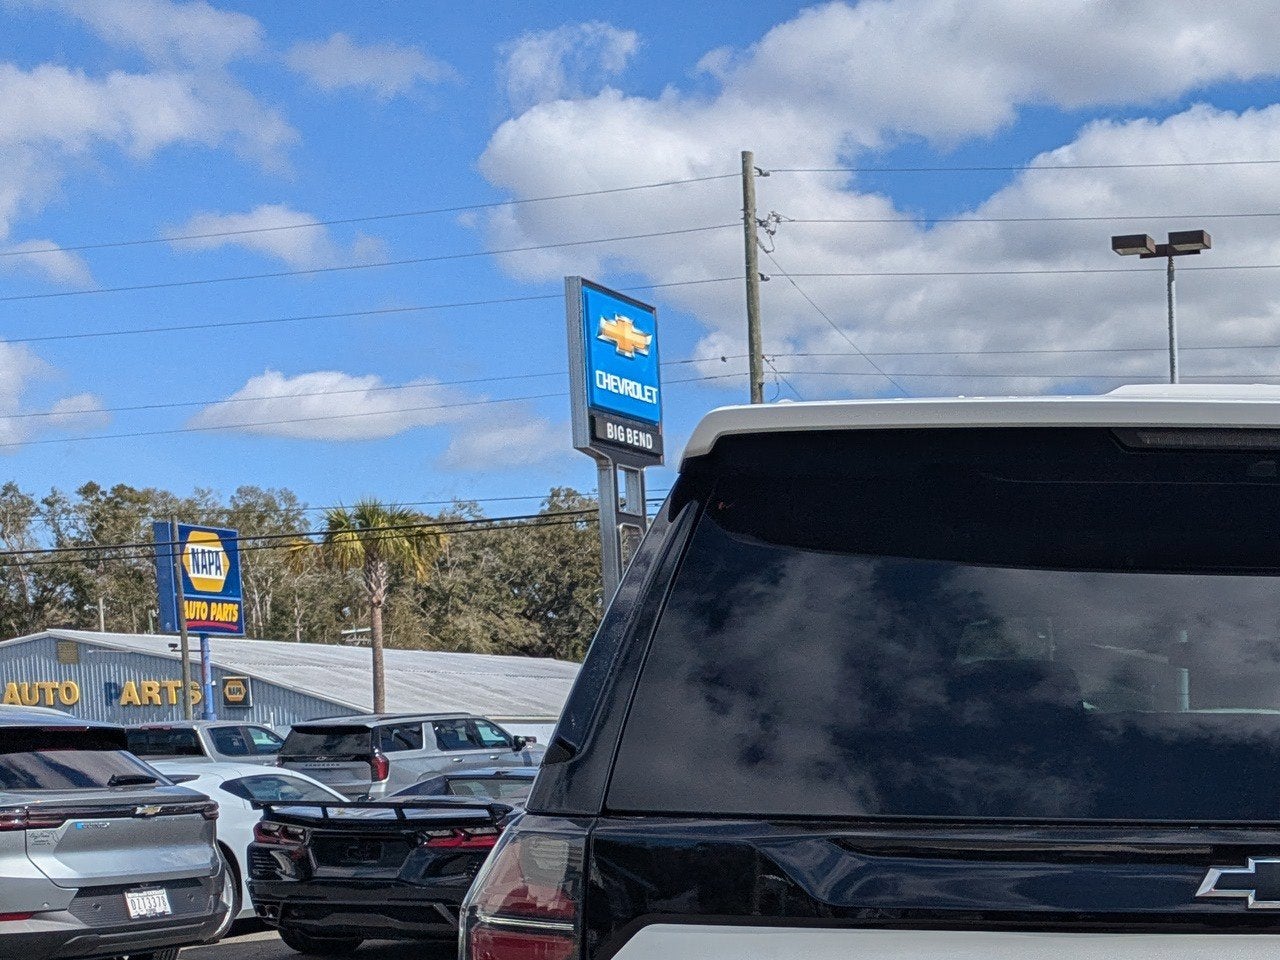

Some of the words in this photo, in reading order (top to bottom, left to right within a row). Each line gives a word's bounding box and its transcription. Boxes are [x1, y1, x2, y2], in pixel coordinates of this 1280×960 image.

[595, 370, 658, 404] CHEVROLET
[606, 422, 625, 442] BIG
[626, 428, 653, 449] BEND
[191, 548, 222, 576] NAPA
[210, 602, 239, 622] PARTS
[3, 681, 80, 706] AUTO
